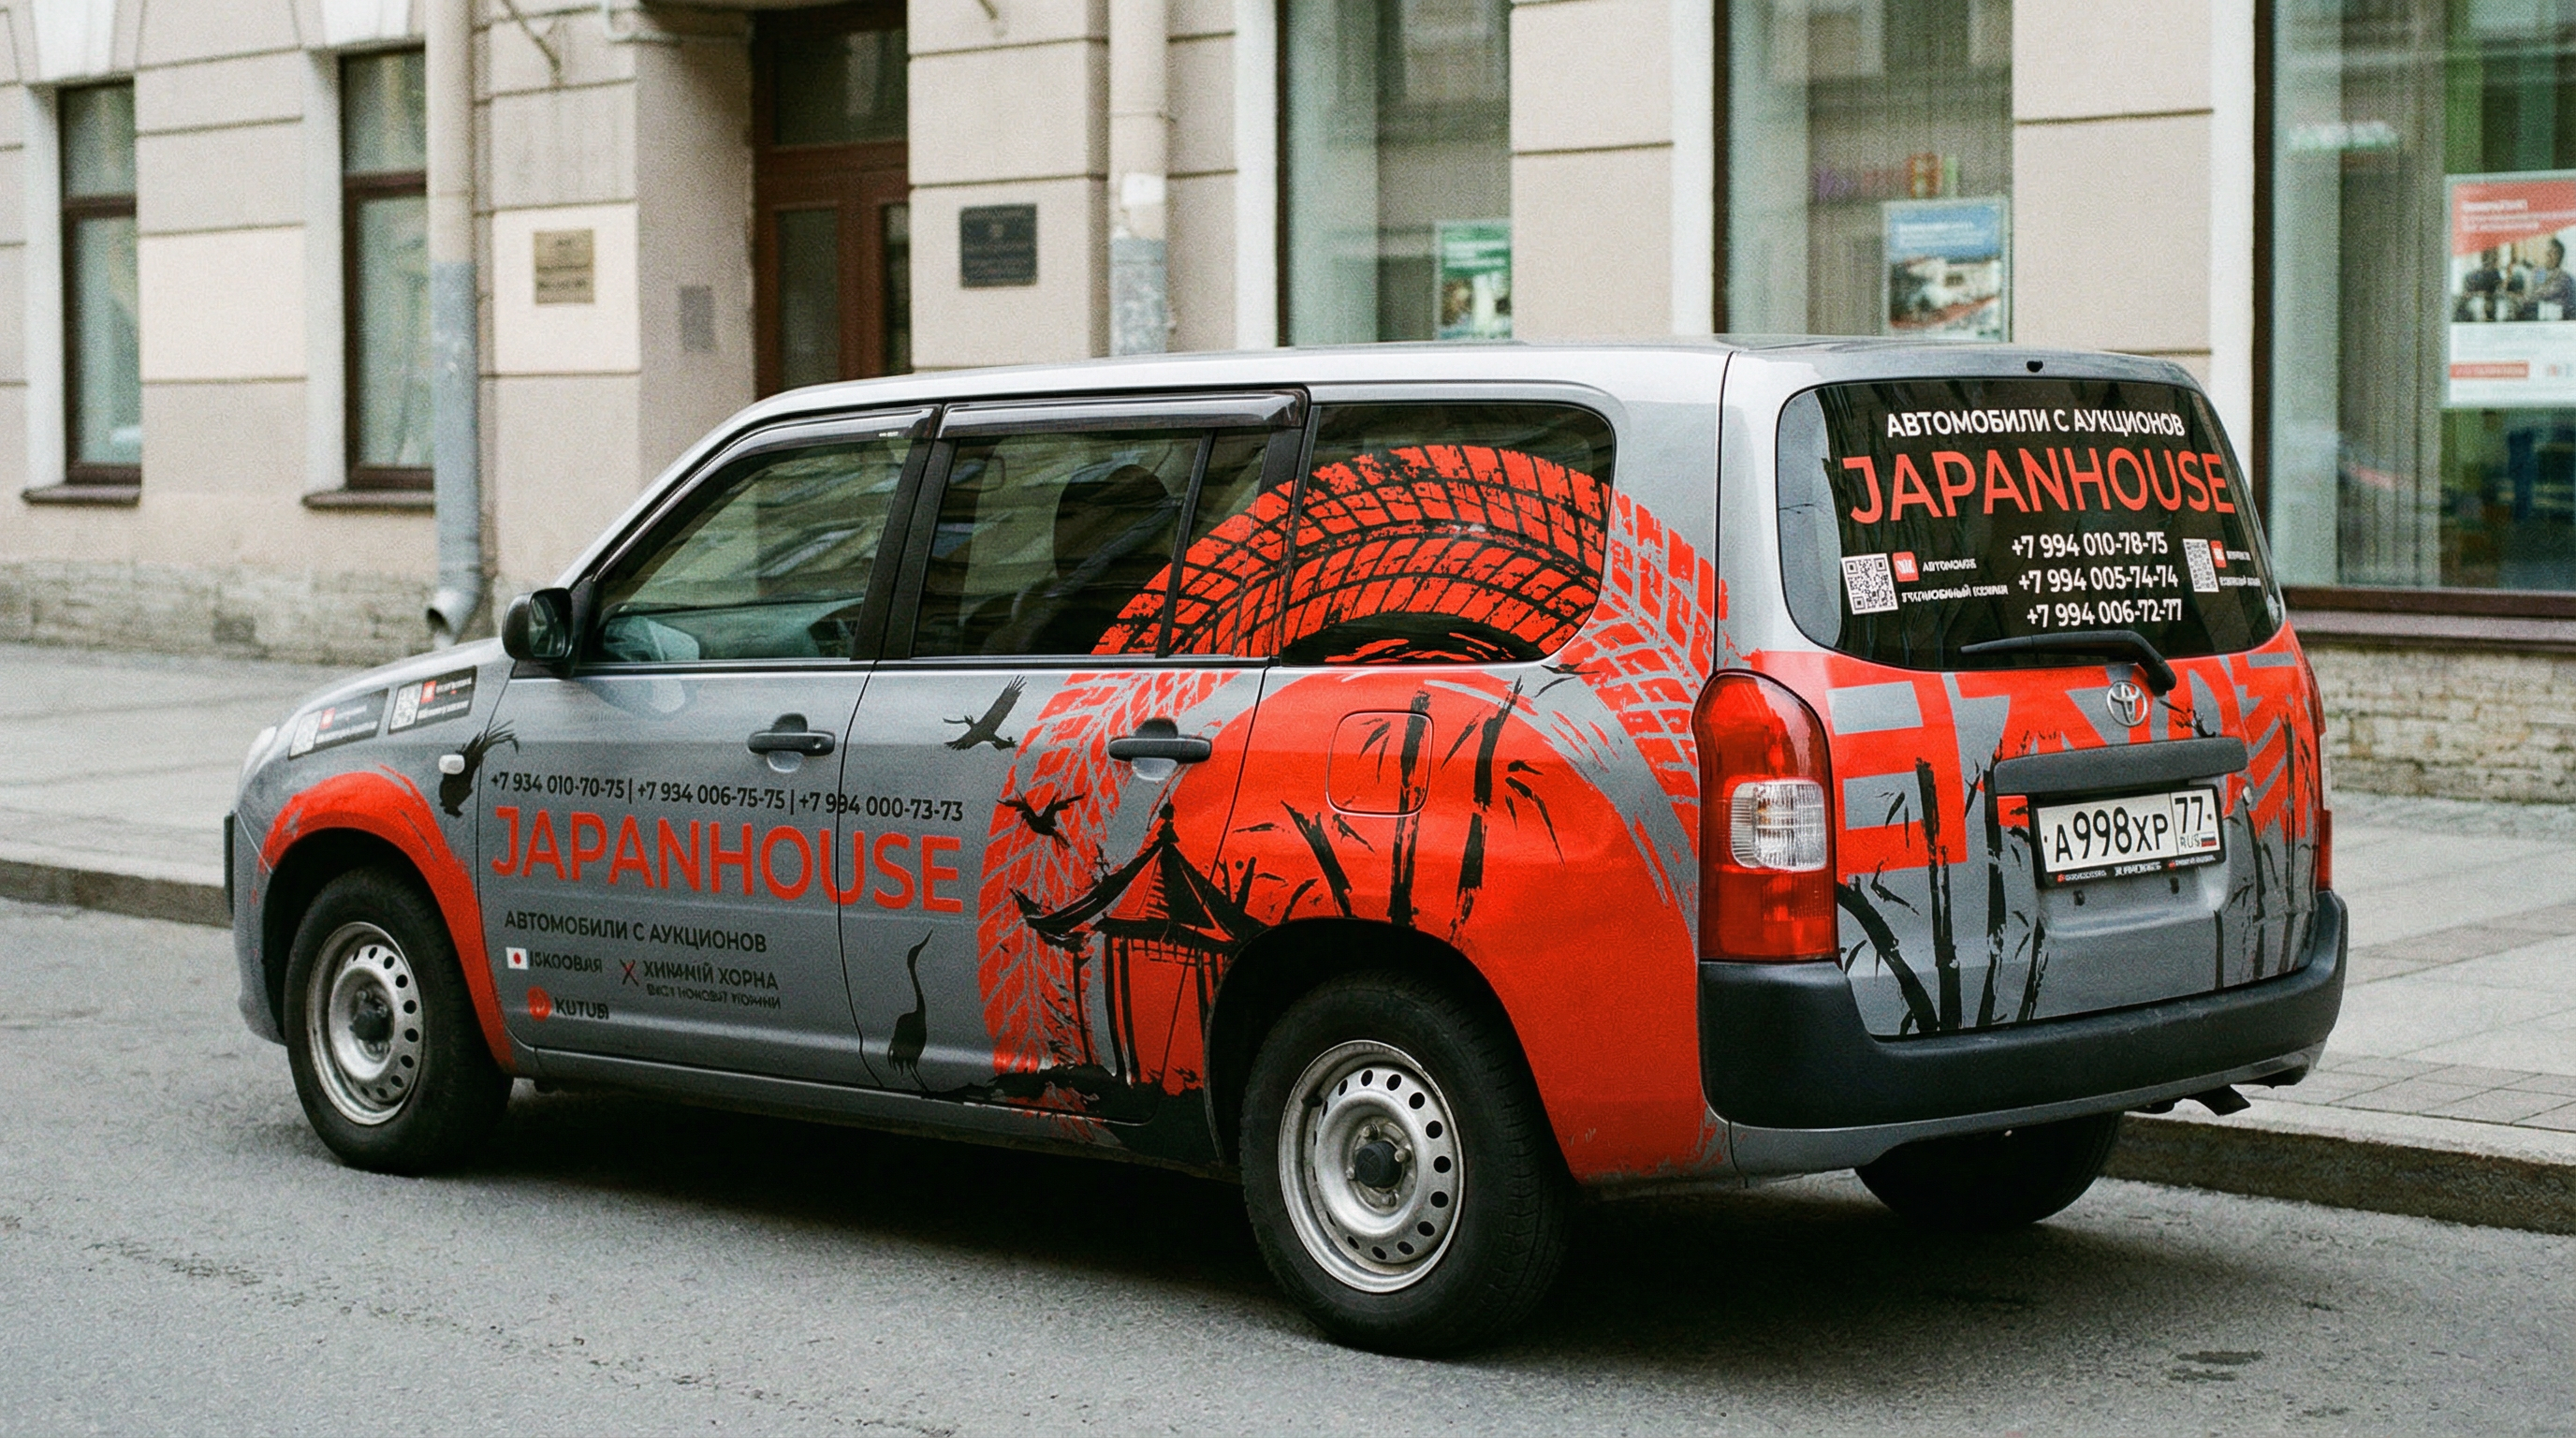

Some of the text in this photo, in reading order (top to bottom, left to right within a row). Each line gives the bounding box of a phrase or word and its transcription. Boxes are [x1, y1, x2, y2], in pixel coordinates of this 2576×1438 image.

[1887, 409, 2186, 438] АВТОМОБИЛИ С АУКЦИОНОВ
[1842, 448, 2236, 524] JAPANHOUSE
[2012, 531, 2169, 559] +7 994 010-78-75
[2018, 569, 2042, 594] +7
[2047, 567, 2087, 593] 994
[2090, 565, 2179, 590] 005-74-74
[2027, 598, 2182, 628] +7 994 006-72-77
[490, 771, 509, 790] +7
[547, 775, 625, 799] 010-70-75
[637, 781, 657, 800] +7
[697, 785, 785, 809] 006-75-75
[798, 792, 821, 812] +7
[866, 796, 963, 822] 000-73-73
[2174, 796, 2203, 834] 77
[2056, 806, 2169, 863] А998ХР
[2180, 833, 2201, 848] RUS
[491, 805, 964, 914] JAPANHOUSE
[505, 911, 767, 953] АВТОМОБИЛИ С АУКЦИОНОВ
[718, 967, 779, 990] ХОРНА
